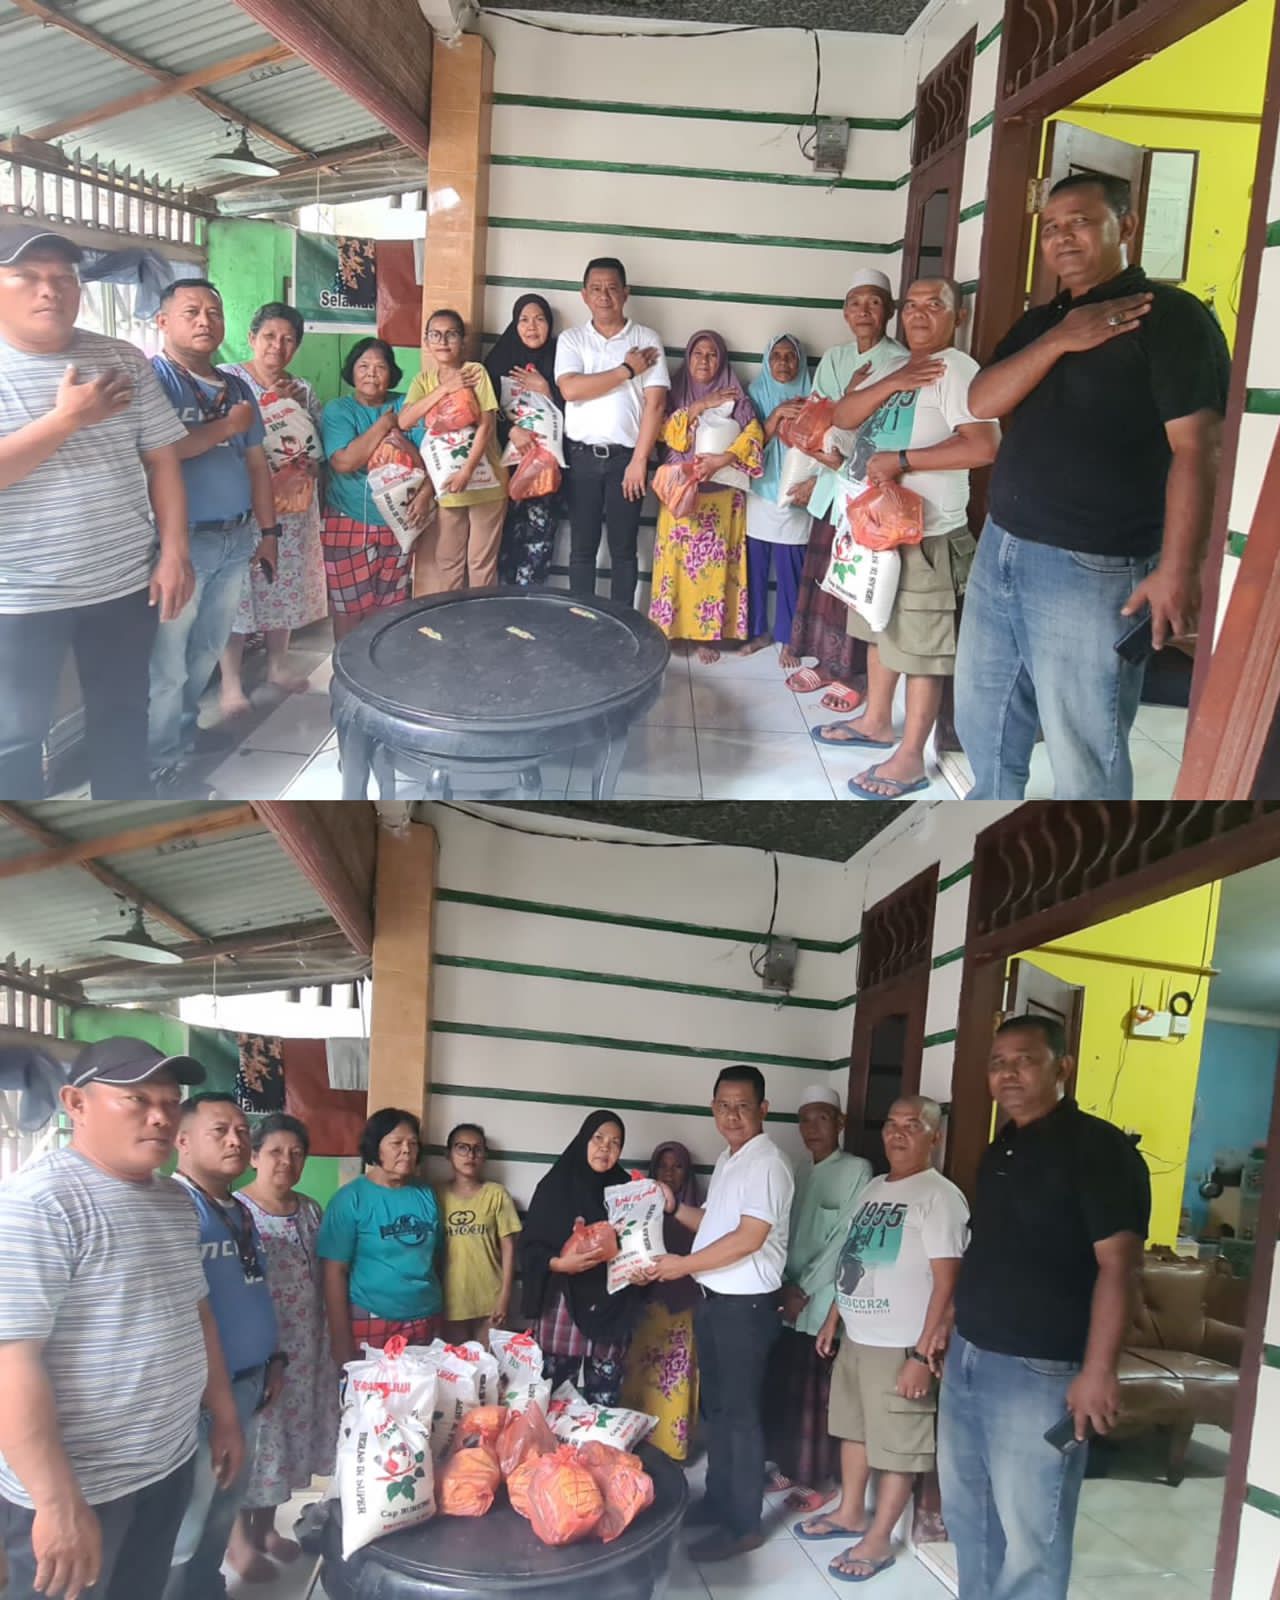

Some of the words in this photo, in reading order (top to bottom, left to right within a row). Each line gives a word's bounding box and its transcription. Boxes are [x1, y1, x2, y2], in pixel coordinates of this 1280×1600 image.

[320, 289, 376, 311] Sela
[855, 1200, 908, 1228] 1955
[380, 1510, 399, 1520] Cap
